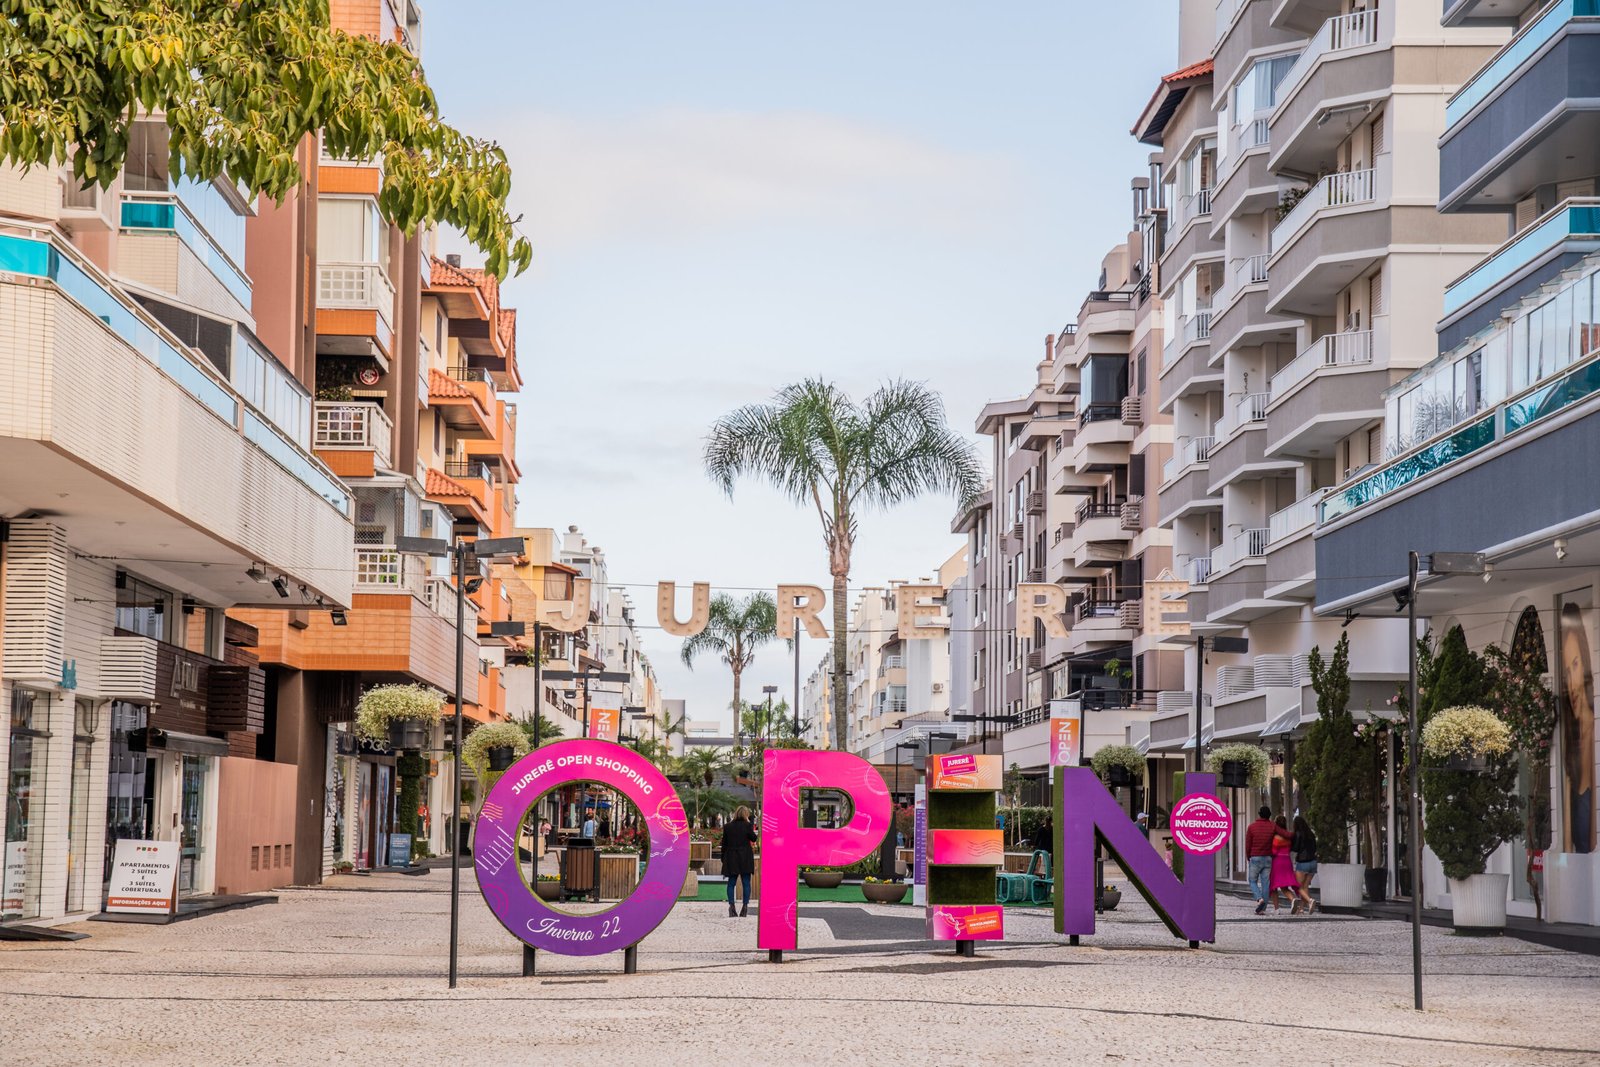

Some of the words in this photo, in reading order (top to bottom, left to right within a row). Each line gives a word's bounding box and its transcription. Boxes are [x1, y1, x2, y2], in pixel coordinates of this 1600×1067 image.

[546, 568, 1191, 639] JURERÊ
[597, 712, 611, 740] PEN
[1058, 721, 1071, 764] OPEN
[511, 759, 555, 795] JURERÊ
[557, 755, 593, 767] OPEN
[595, 756, 653, 795] SHOPPING
[948, 757, 969, 766] JURERÊ
[1175, 819, 1228, 829] INVERNO2022
[474, 739, 1217, 955] OPEN
[526, 918, 595, 941] Inverno
[600, 916, 620, 938] 22
